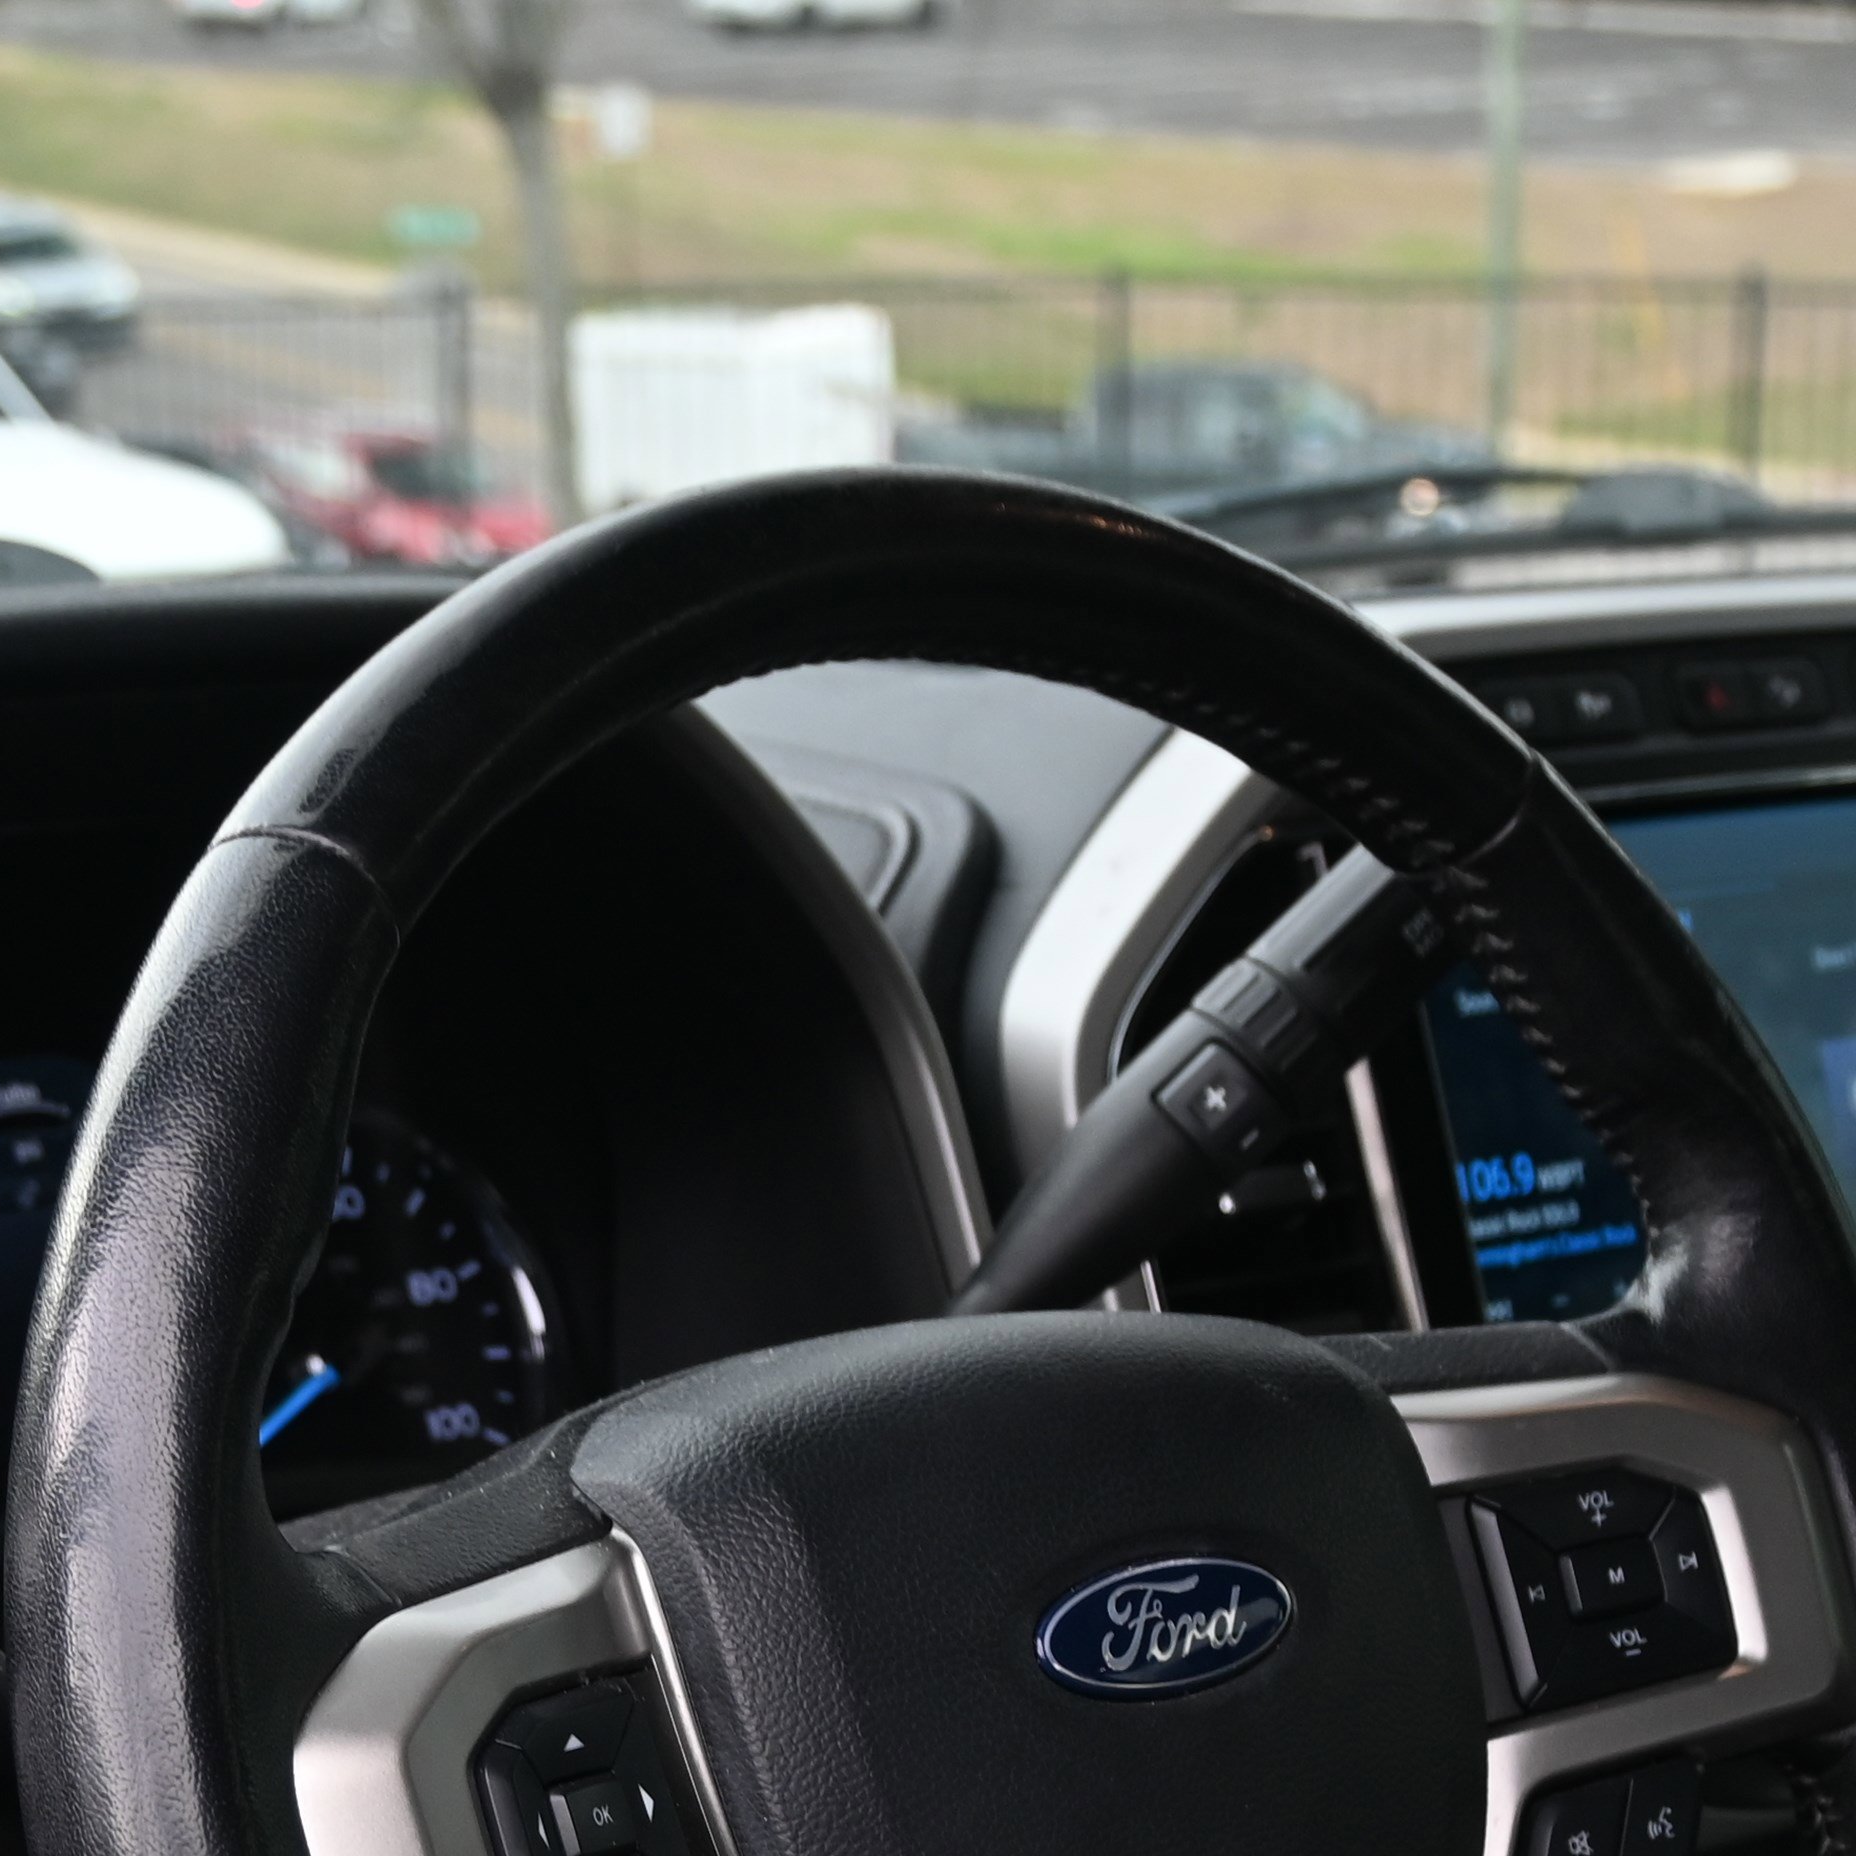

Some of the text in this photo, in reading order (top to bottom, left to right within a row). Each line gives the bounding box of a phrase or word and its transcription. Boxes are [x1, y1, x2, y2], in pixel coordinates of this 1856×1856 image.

[1456, 1152, 1536, 1202] 106.9
[406, 1266, 458, 1307] 80
[424, 1402, 480, 1441] 100
[1577, 1490, 1614, 1513] VOL
[1608, 1566, 1626, 1585] M
[1101, 1573, 1247, 1672] Ford
[1609, 1628, 1648, 1650] VOL
[593, 1805, 614, 1827] OK
